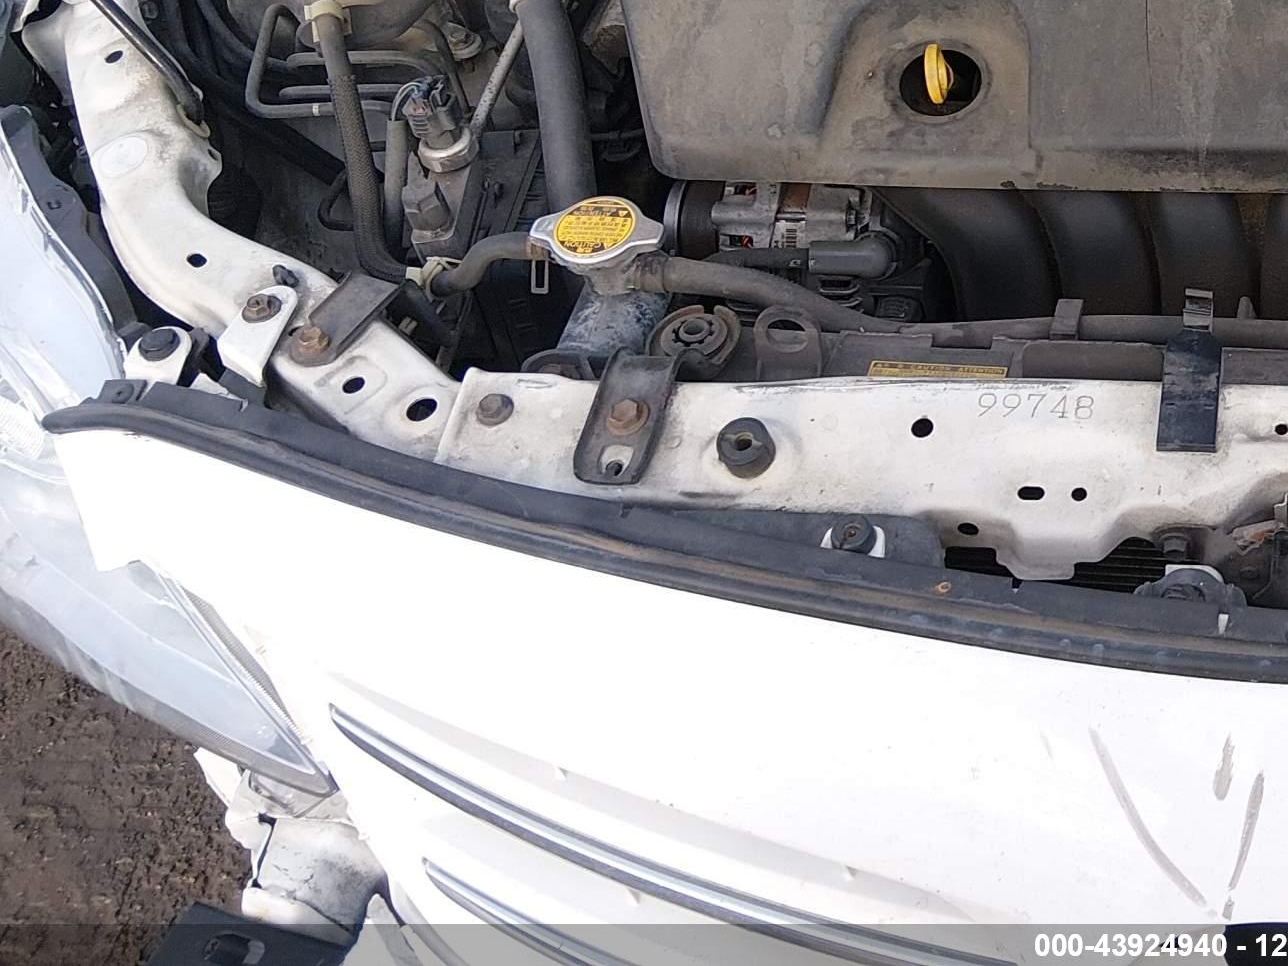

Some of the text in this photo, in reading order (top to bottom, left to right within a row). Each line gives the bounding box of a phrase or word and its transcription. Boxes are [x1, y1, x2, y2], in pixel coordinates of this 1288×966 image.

[562, 240, 602, 249] CAUTION
[959, 366, 1005, 374] ATTENTION
[977, 393, 1095, 420] 99748
